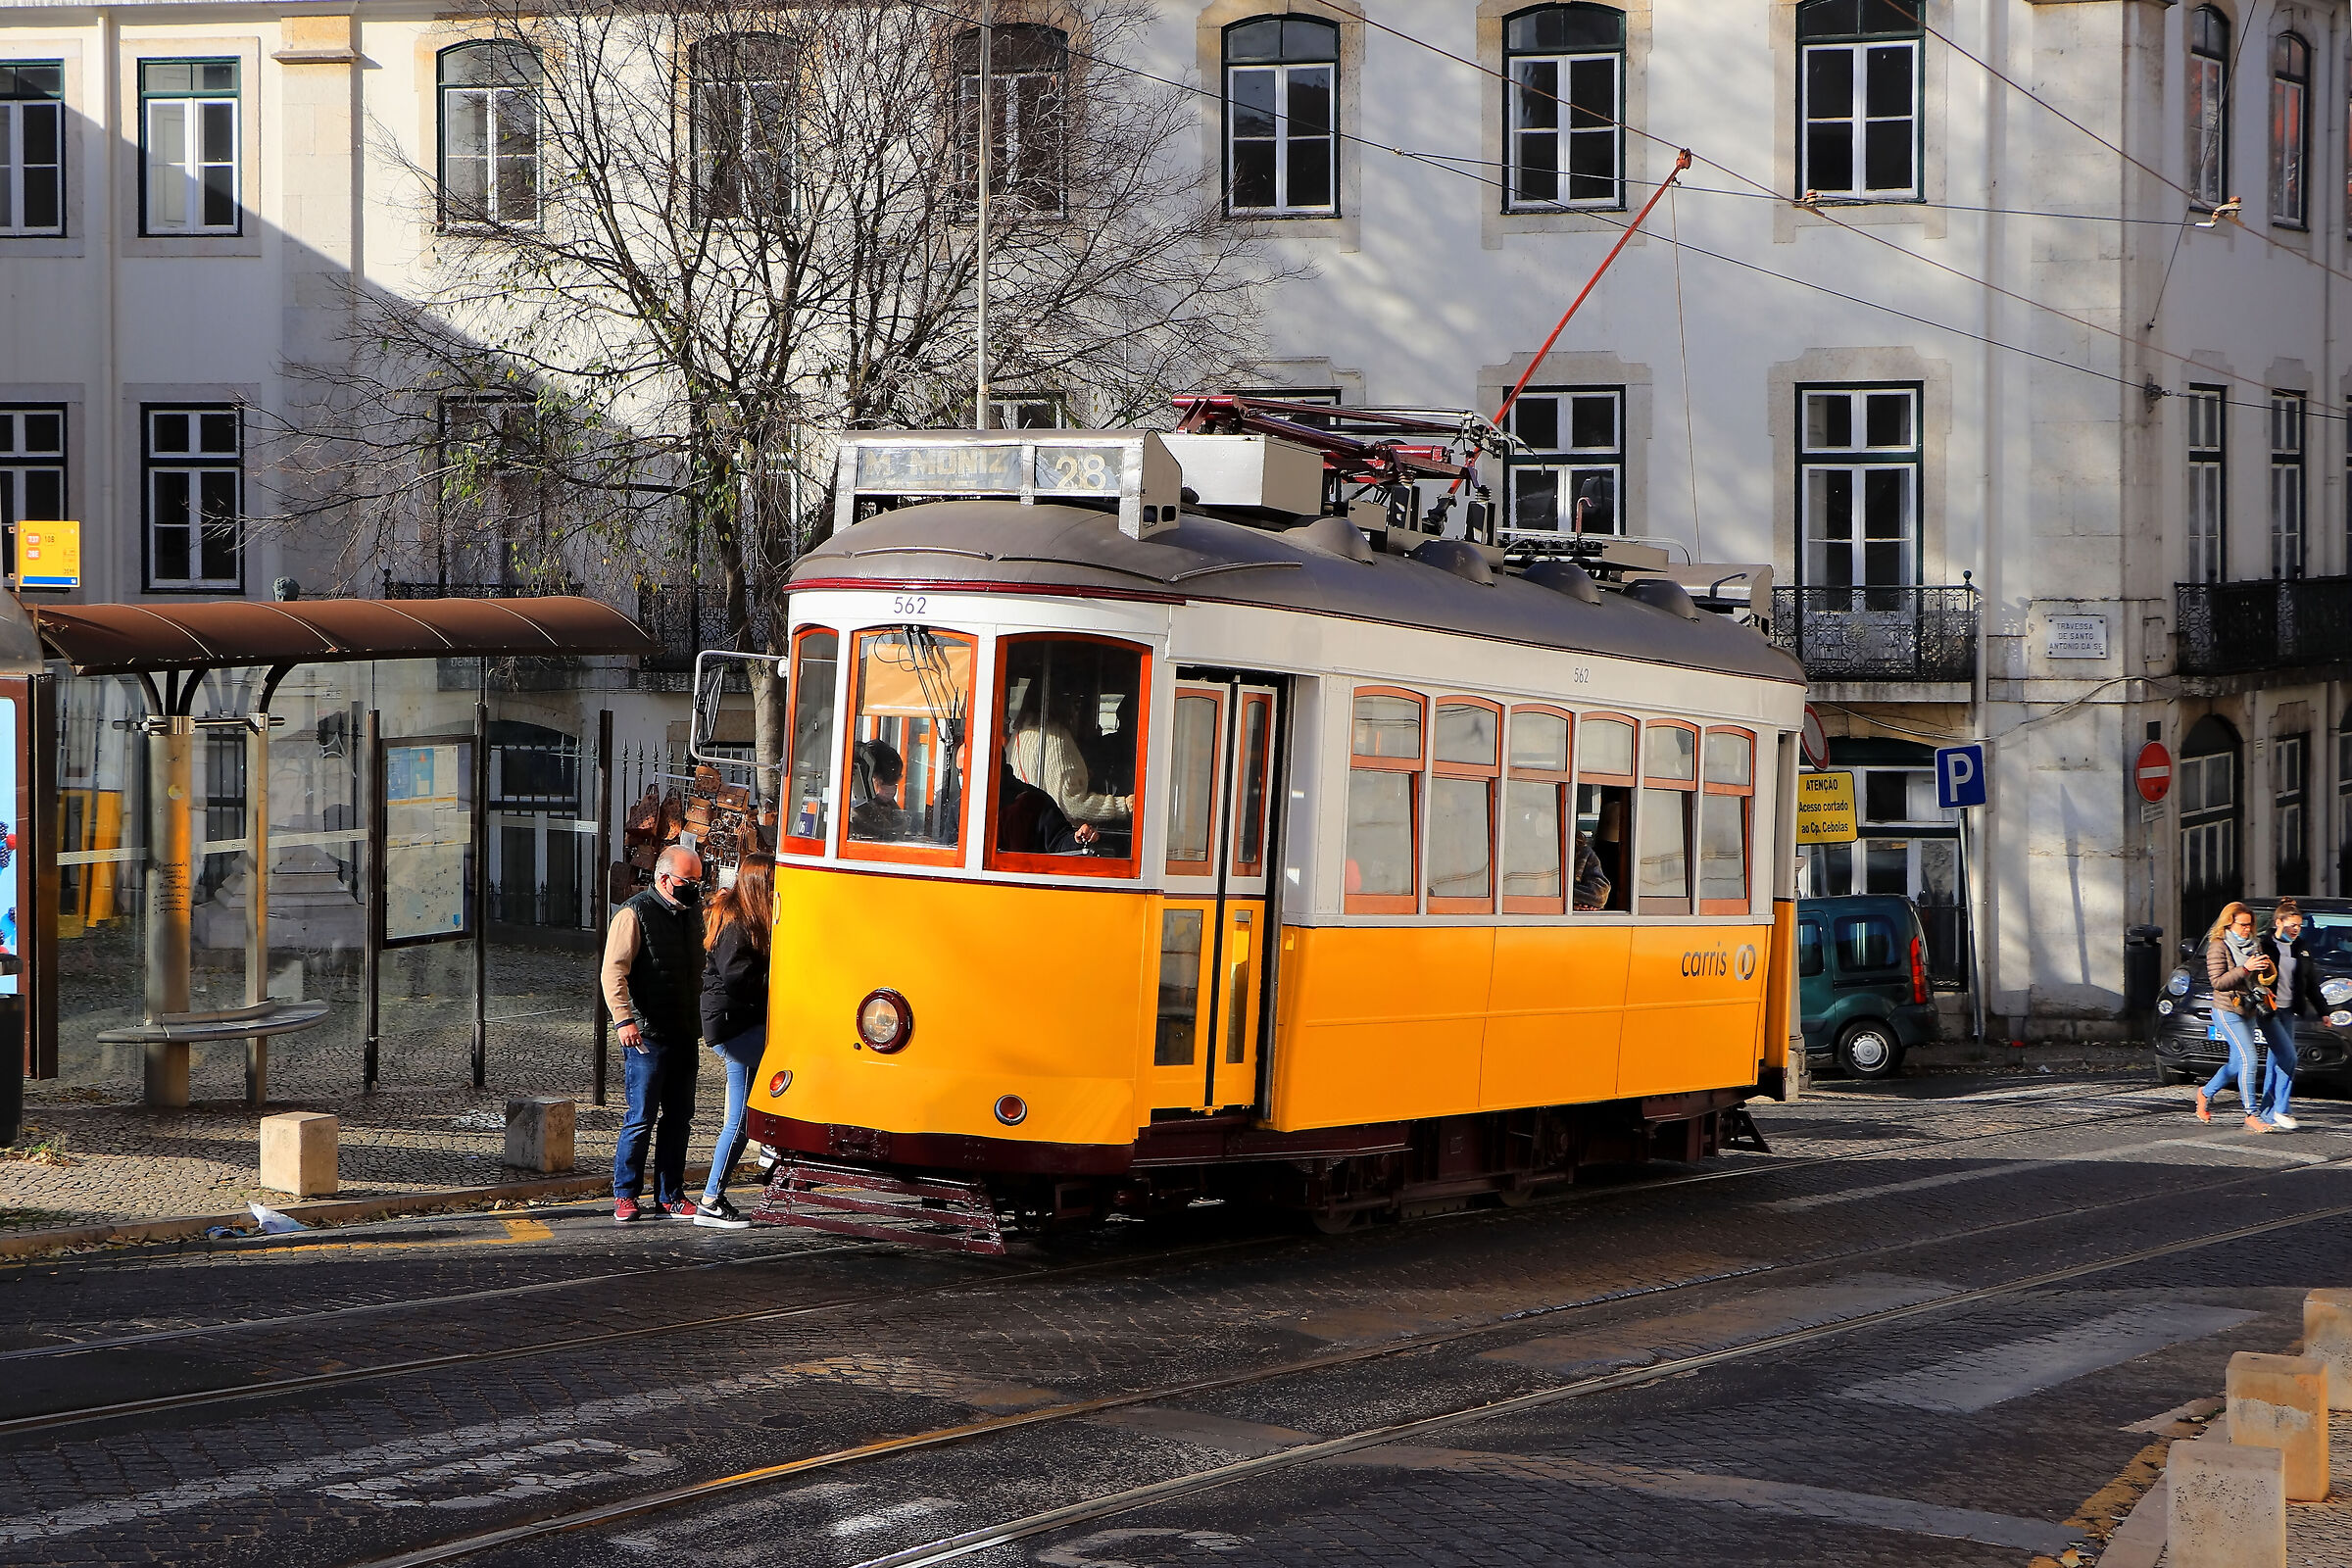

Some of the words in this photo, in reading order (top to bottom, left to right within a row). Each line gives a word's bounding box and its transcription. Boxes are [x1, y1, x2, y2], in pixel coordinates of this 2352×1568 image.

[909, 448, 1007, 475] MONIZ
[1055, 454, 1106, 490] 28
[893, 596, 927, 614] 562
[1573, 667, 1590, 683] 562
[1805, 776, 1838, 794] ATENÇÃO
[1946, 753, 1974, 803] P
[1798, 801, 1822, 813] Acesso
[1823, 799, 1849, 812] cortado
[1801, 824, 1810, 834] ao
[1810, 821, 1822, 836] Cp.
[1822, 820, 1849, 833] Cebolas
[1681, 941, 1727, 977] carris
